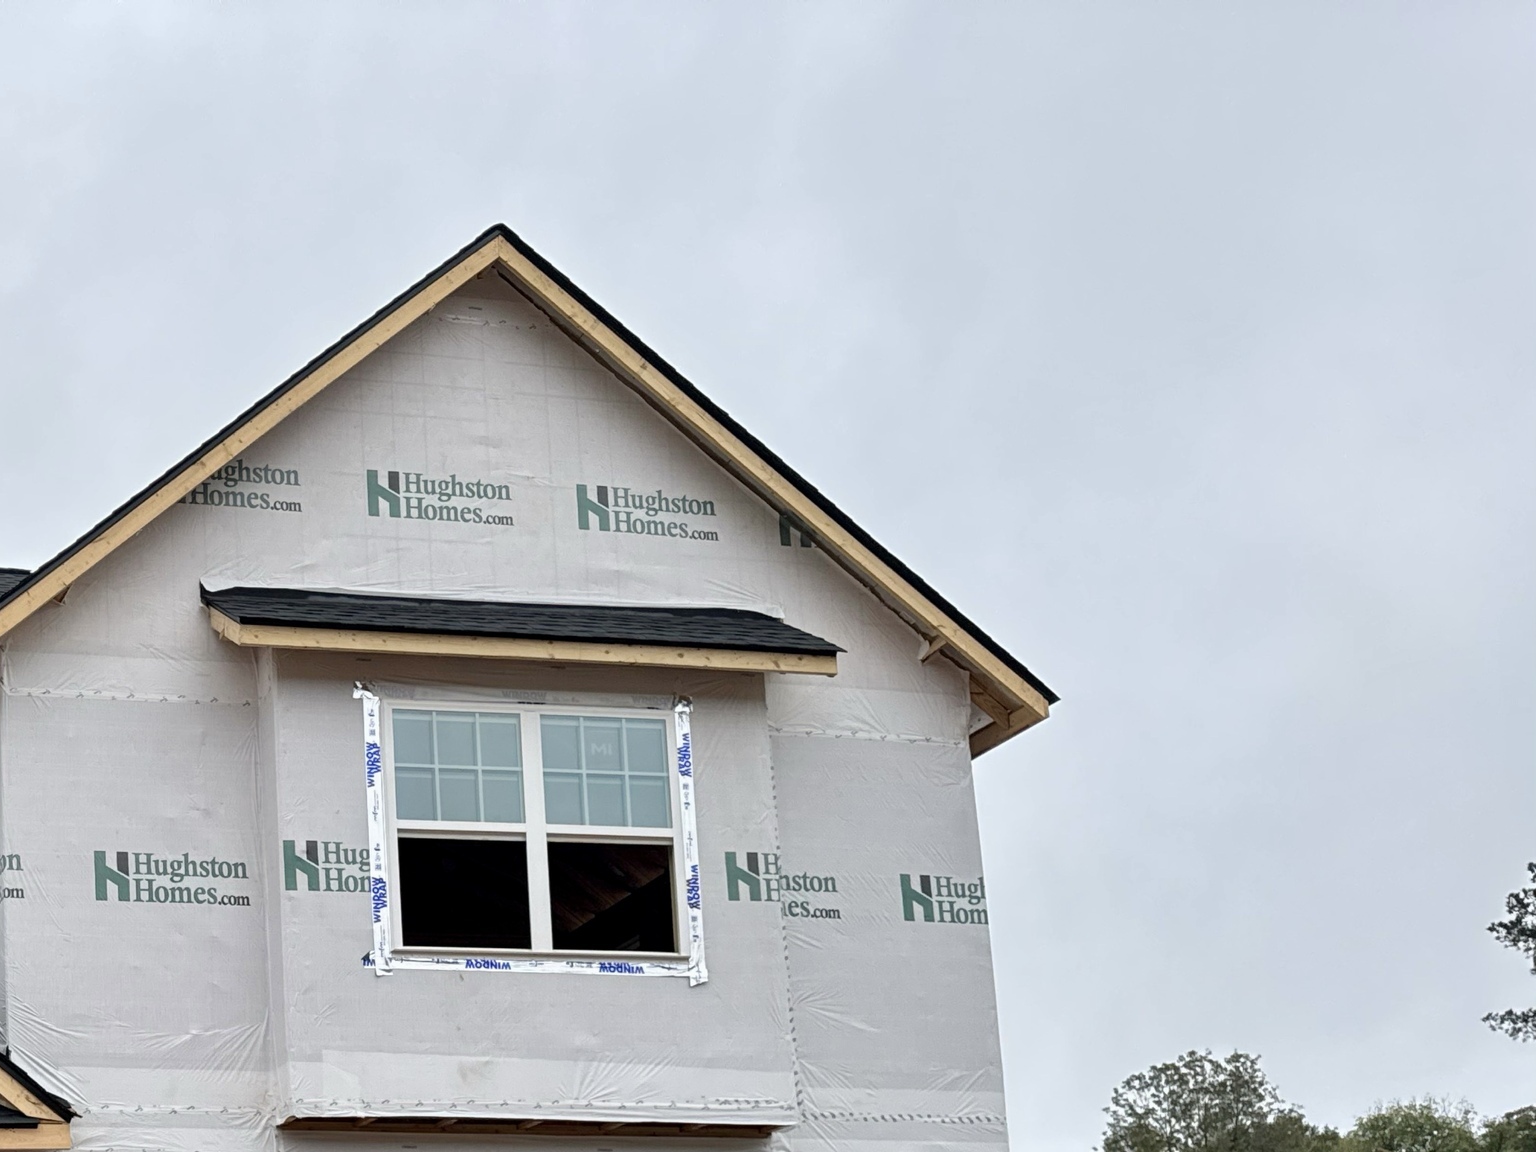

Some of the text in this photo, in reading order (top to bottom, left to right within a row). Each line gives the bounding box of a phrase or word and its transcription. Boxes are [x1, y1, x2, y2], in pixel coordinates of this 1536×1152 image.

[402, 472, 512, 502] Hughston
[611, 487, 717, 517] Hughston
[403, 496, 514, 526] Homes.com
[612, 510, 720, 542] Homes.com
[132, 852, 249, 883] Hughston
[133, 878, 251, 907] Homes.com
